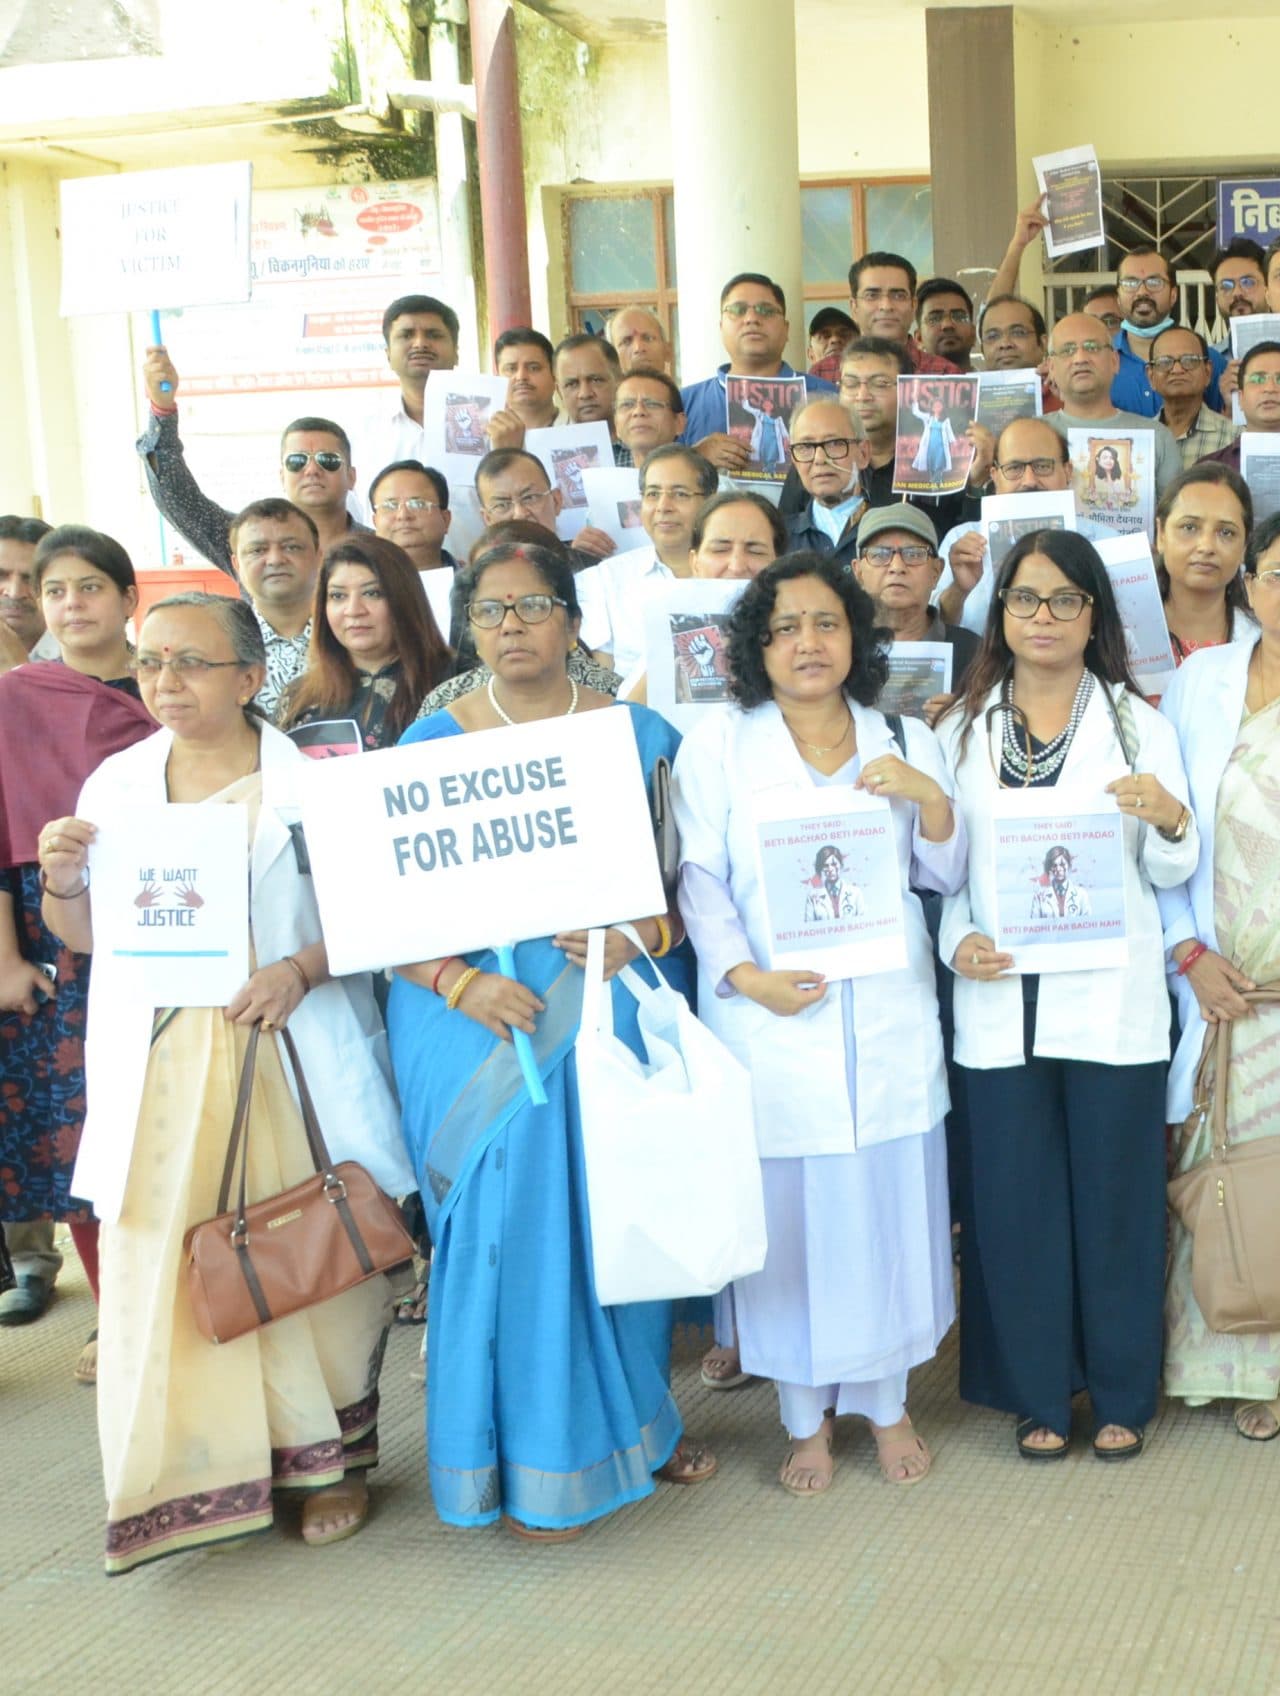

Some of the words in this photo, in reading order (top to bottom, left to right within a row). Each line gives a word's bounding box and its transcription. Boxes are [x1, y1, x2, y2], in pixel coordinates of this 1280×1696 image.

[120, 198, 182, 219] JUSTICE
[135, 226, 169, 244] FOR
[120, 255, 183, 274] VICTIM
[383, 781, 430, 818] NO
[439, 756, 567, 807] EXCUSE
[393, 828, 463, 876] FOR
[472, 806, 578, 862] ABUSE
[764, 838, 785, 848] BETI
[787, 833, 828, 846] BACHAO
[830, 829, 850, 840] BETI
[852, 826, 886, 837] PADAO
[1000, 834, 1019, 844] BETI
[1021, 833, 1058, 843] BACHAO
[1060, 832, 1080, 841] BETI
[1082, 830, 1115, 839] PADAO
[139, 867, 155, 881] WE
[163, 867, 198, 881] WANT
[137, 909, 196, 926] JUSTICE
[1003, 926, 1021, 934] BETI
[1023, 924, 1050, 933] PADHI
[1052, 923, 1070, 932] PAR
[1071, 921, 1098, 930] BACHI
[1099, 919, 1121, 928] NAHI
[776, 931, 796, 941] BETI
[847, 922, 875, 931] BACHI
